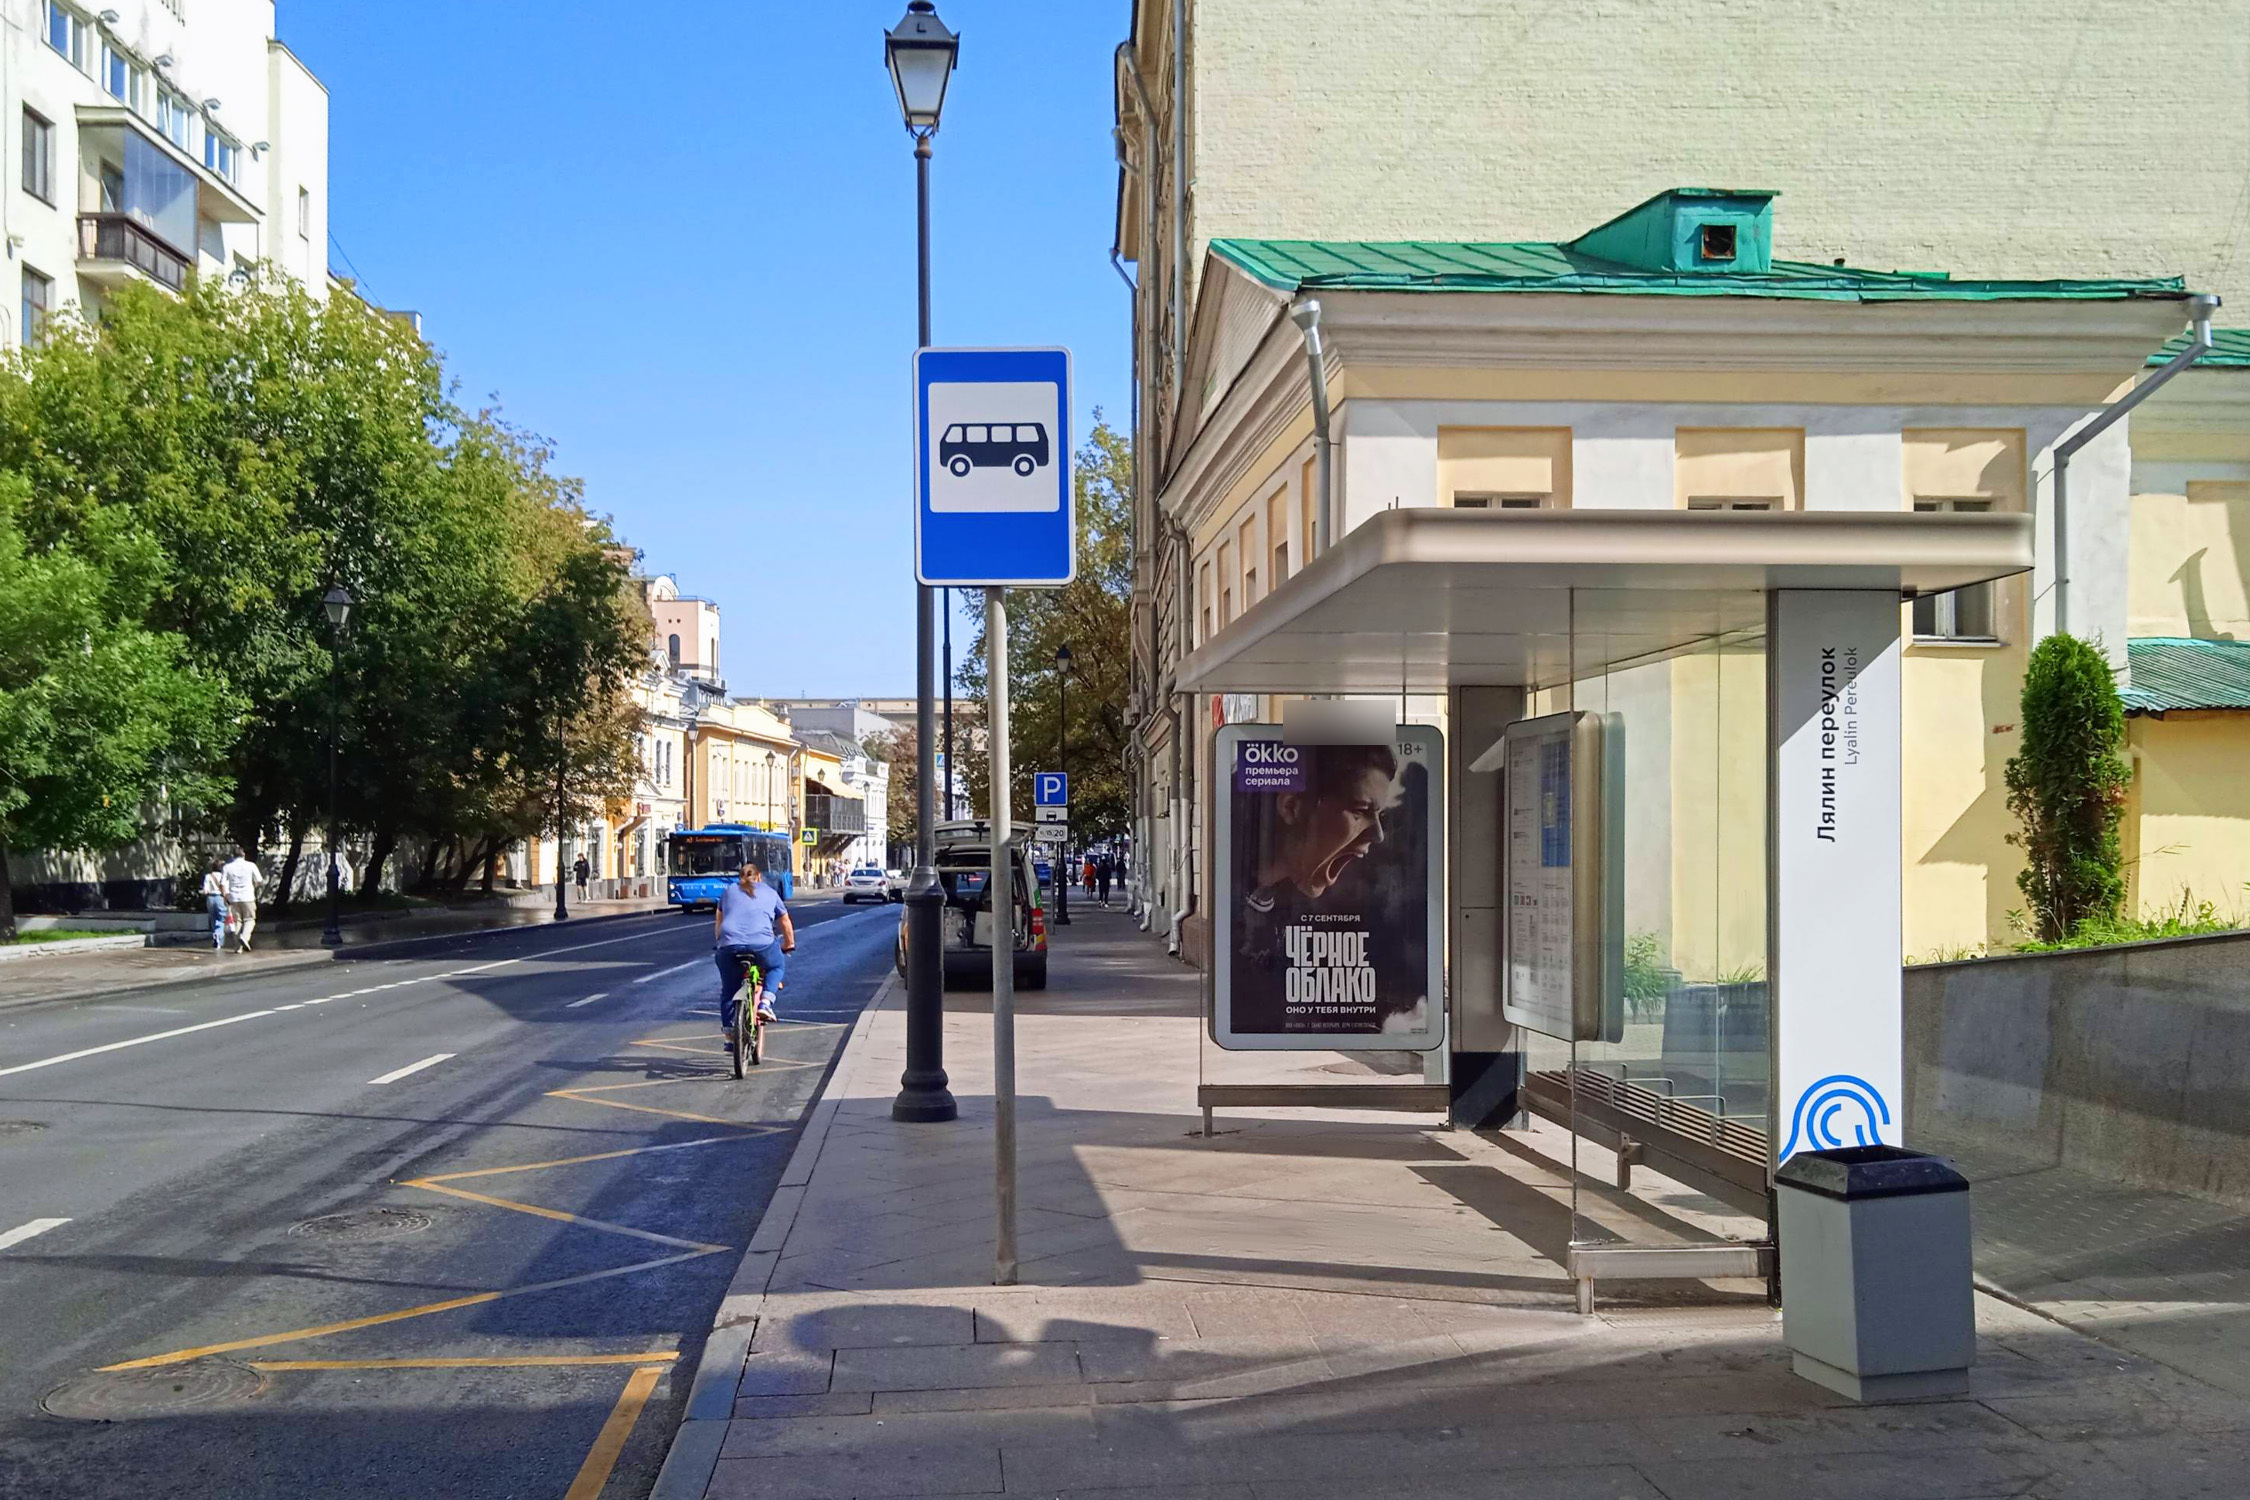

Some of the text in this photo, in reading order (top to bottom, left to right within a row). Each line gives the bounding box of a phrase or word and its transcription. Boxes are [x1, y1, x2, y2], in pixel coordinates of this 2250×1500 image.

[1844, 647, 1860, 765] Lyalin Pereulok
[1397, 743, 1423, 756] 18+
[1817, 647, 1840, 843] Лялин переулок
[1245, 767, 1299, 777] премьера
[1245, 778, 1290, 787] сериала
[1043, 776, 1062, 803] P
[1054, 829, 1064, 837] 20
[1300, 914, 1361, 922] С 7 СЕНТЯБРЯ
[1285, 925, 1370, 967] ЧЁРНОЕ
[1285, 967, 1376, 1003] ОБЛАКО
[1285, 1006, 1376, 1014] ОНО У ТЕБЯ ВНУТРИ
